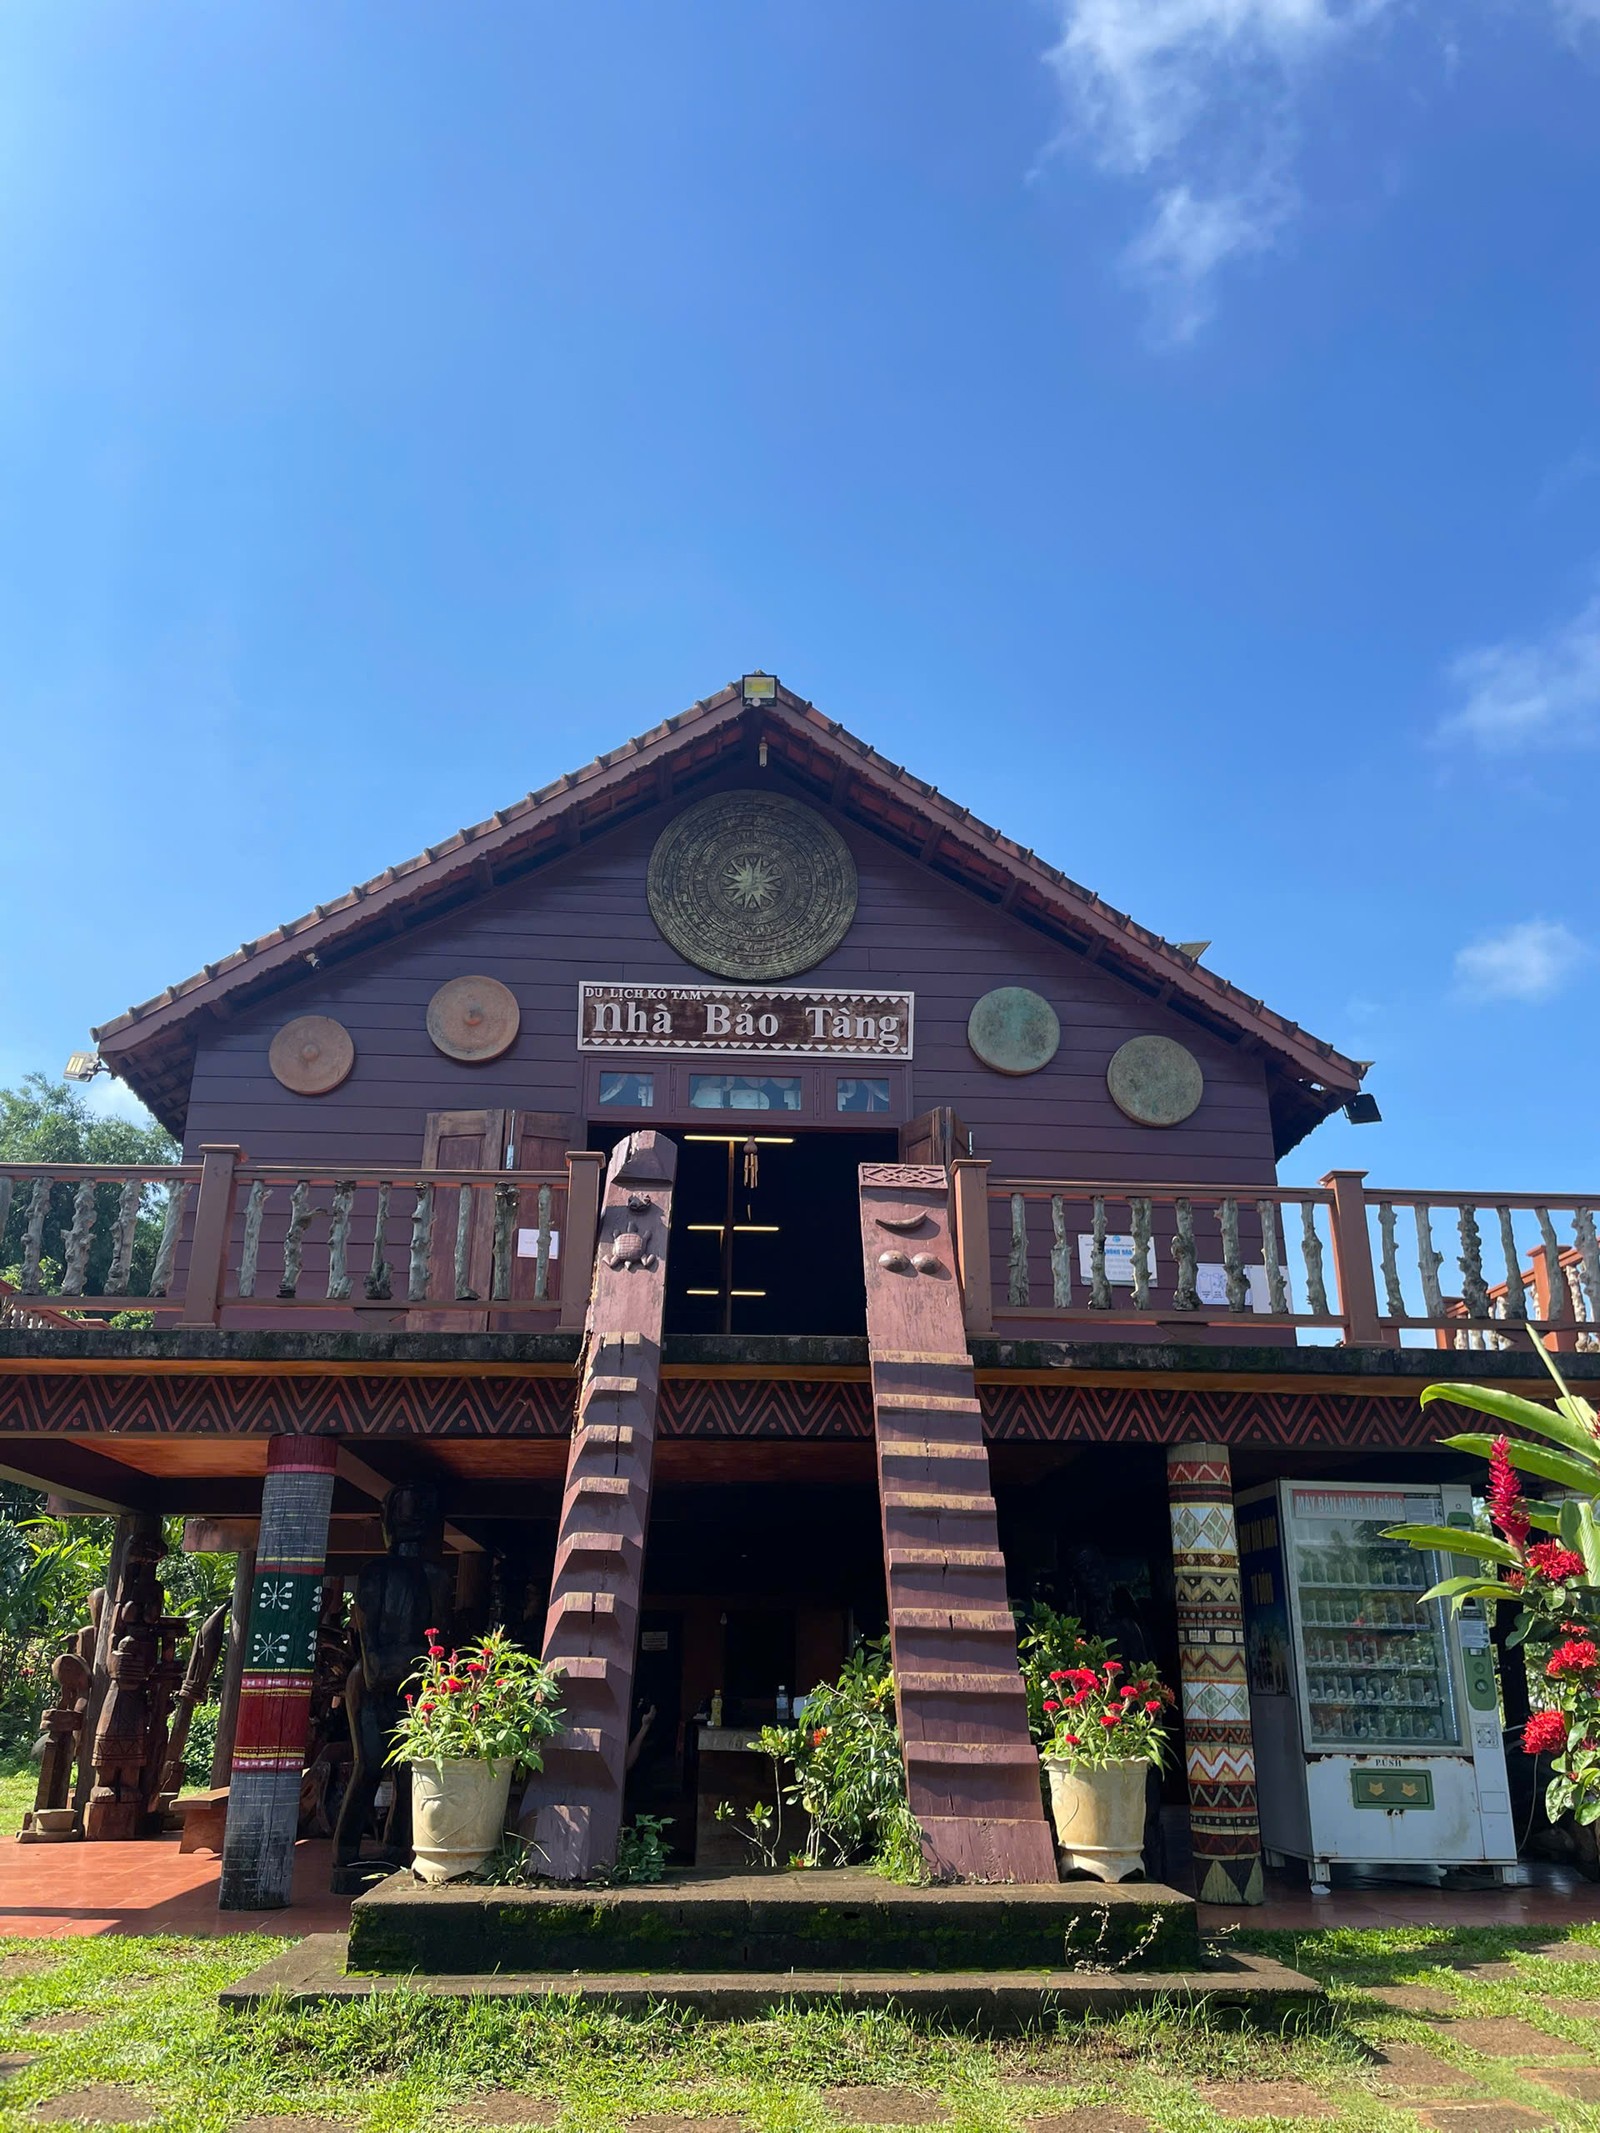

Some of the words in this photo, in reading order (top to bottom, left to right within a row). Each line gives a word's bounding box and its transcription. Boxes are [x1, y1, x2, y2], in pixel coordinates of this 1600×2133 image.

[584, 987, 603, 998] DU
[610, 988, 644, 1002] LỊCH
[670, 989, 702, 1000] TAM
[703, 1002, 780, 1037] Bảo
[805, 1006, 900, 1047] Tàng
[1375, 1758, 1402, 1767] PUSH
